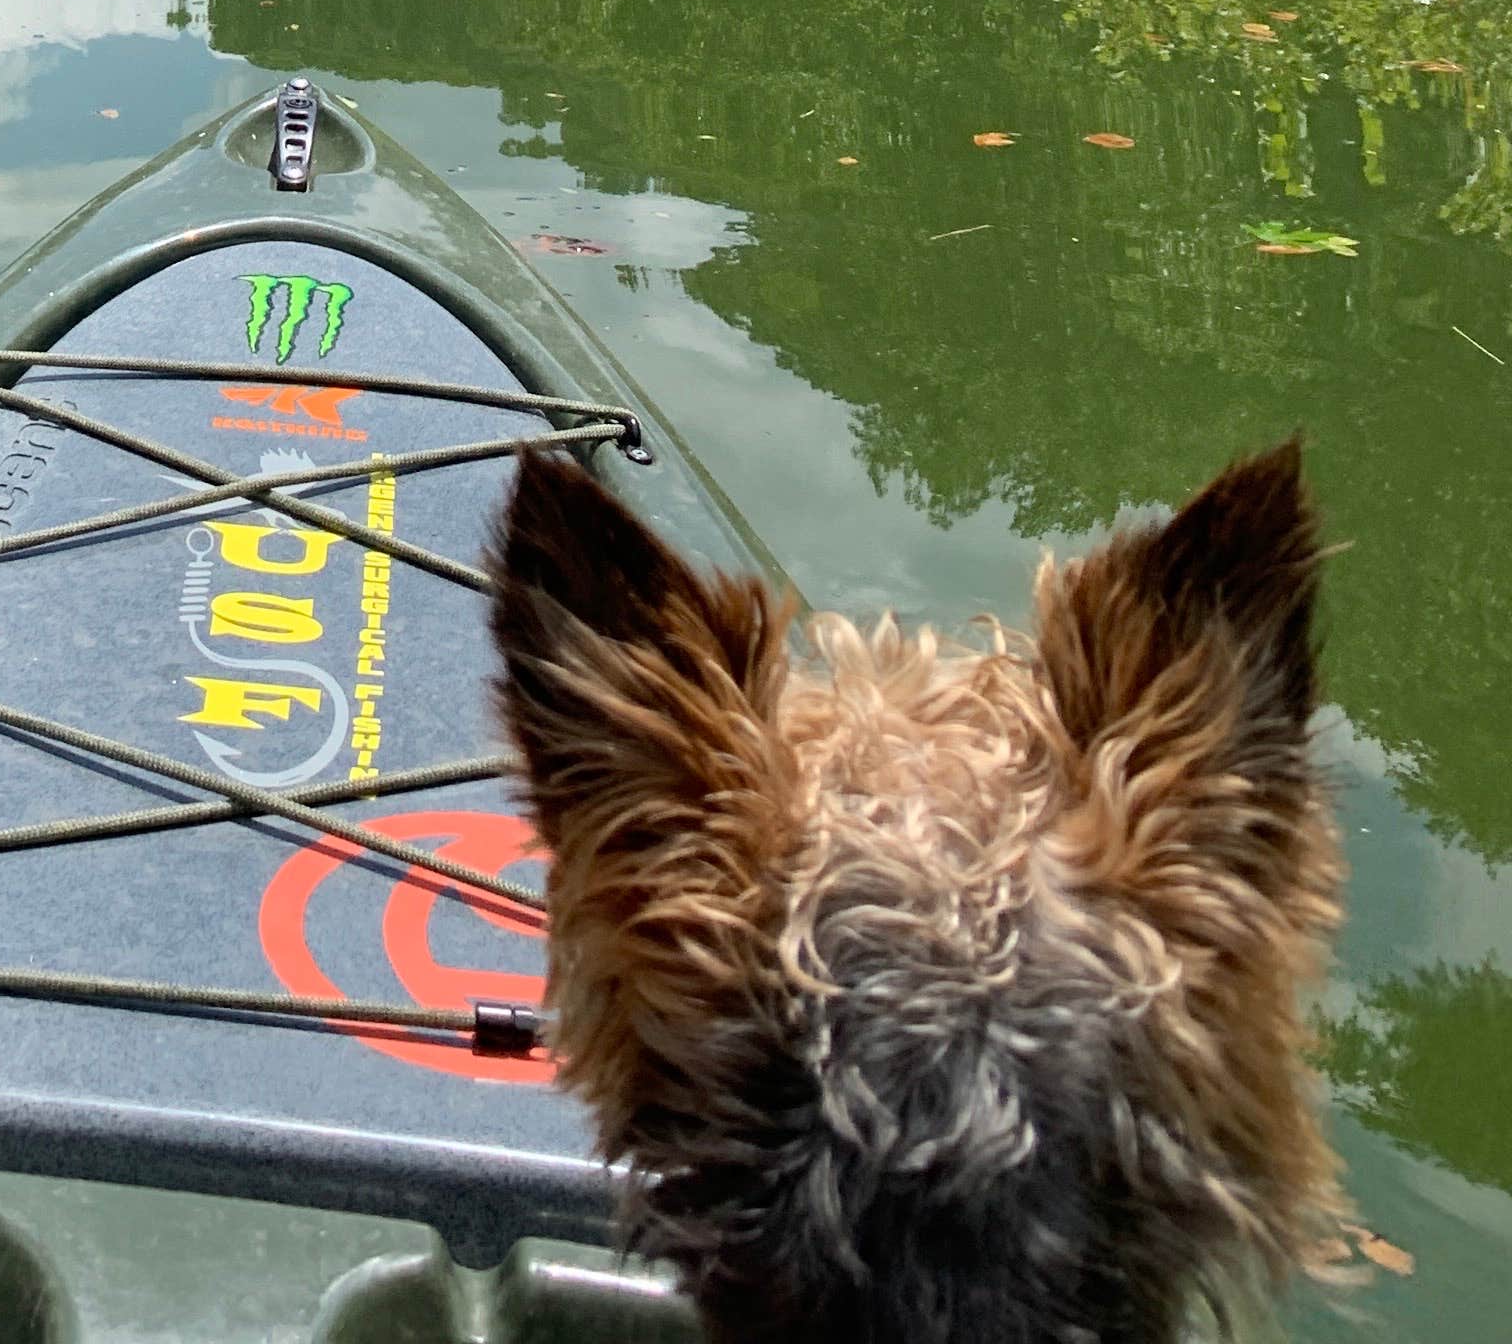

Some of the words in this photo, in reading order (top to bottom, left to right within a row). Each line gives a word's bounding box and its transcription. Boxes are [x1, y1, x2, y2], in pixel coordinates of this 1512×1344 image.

[367, 452, 395, 538] RGEN
[356, 551, 391, 676] SURGICAL
[349, 683, 384, 800] FISHIN
